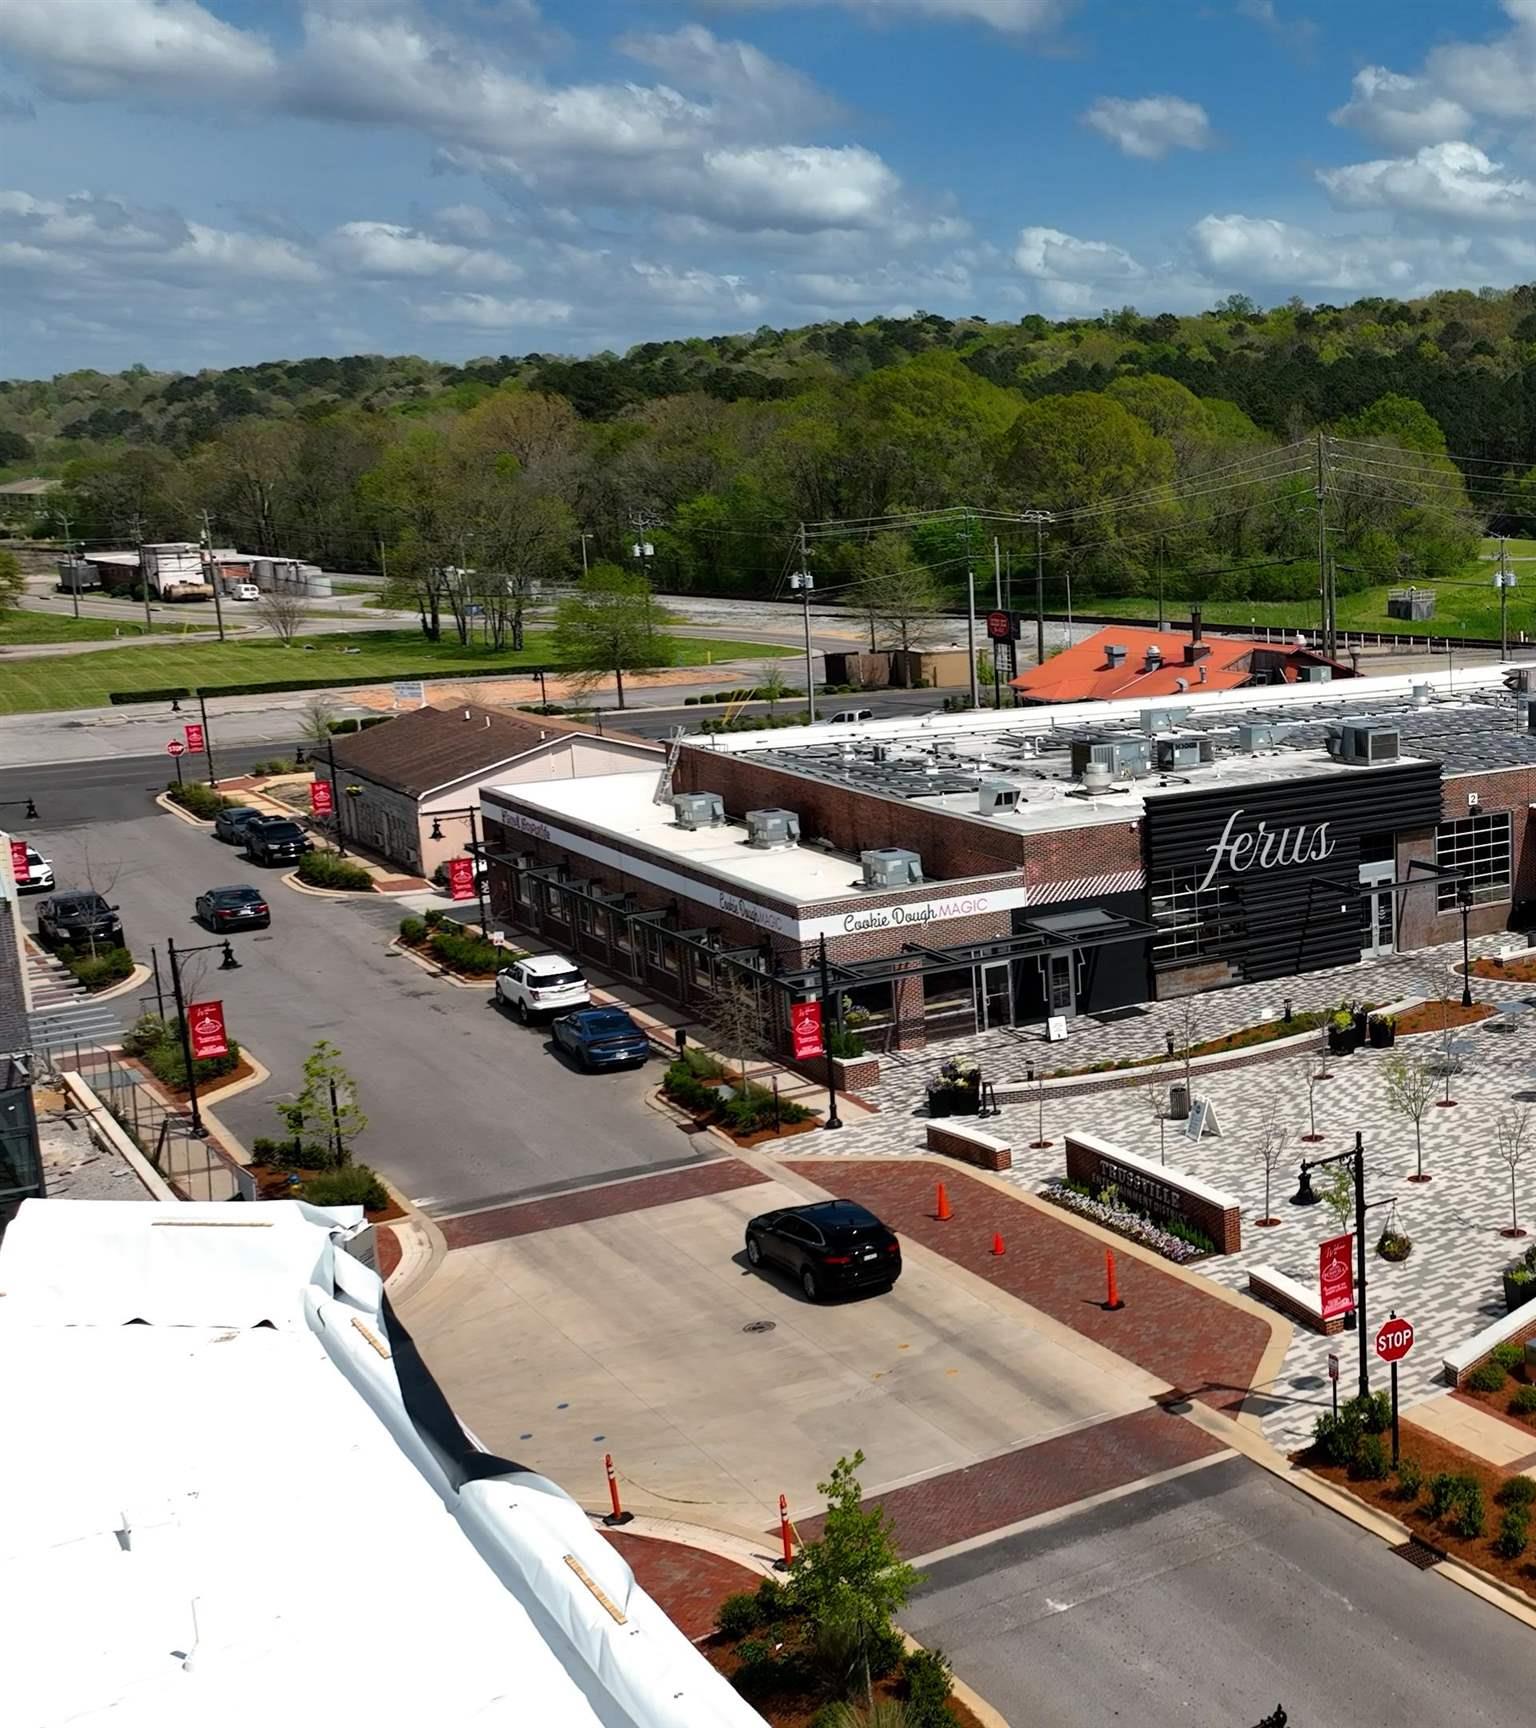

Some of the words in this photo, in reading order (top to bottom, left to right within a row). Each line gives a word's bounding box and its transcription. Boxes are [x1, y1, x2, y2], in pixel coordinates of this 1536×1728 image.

[1185, 809, 1336, 893] ferus
[843, 911, 890, 933] Cookie
[891, 903, 938, 929] Dough
[938, 897, 988, 918] MAGIC
[1099, 1160, 1181, 1209] TRUSSVILLE
[1378, 1329, 1411, 1351] STOP
